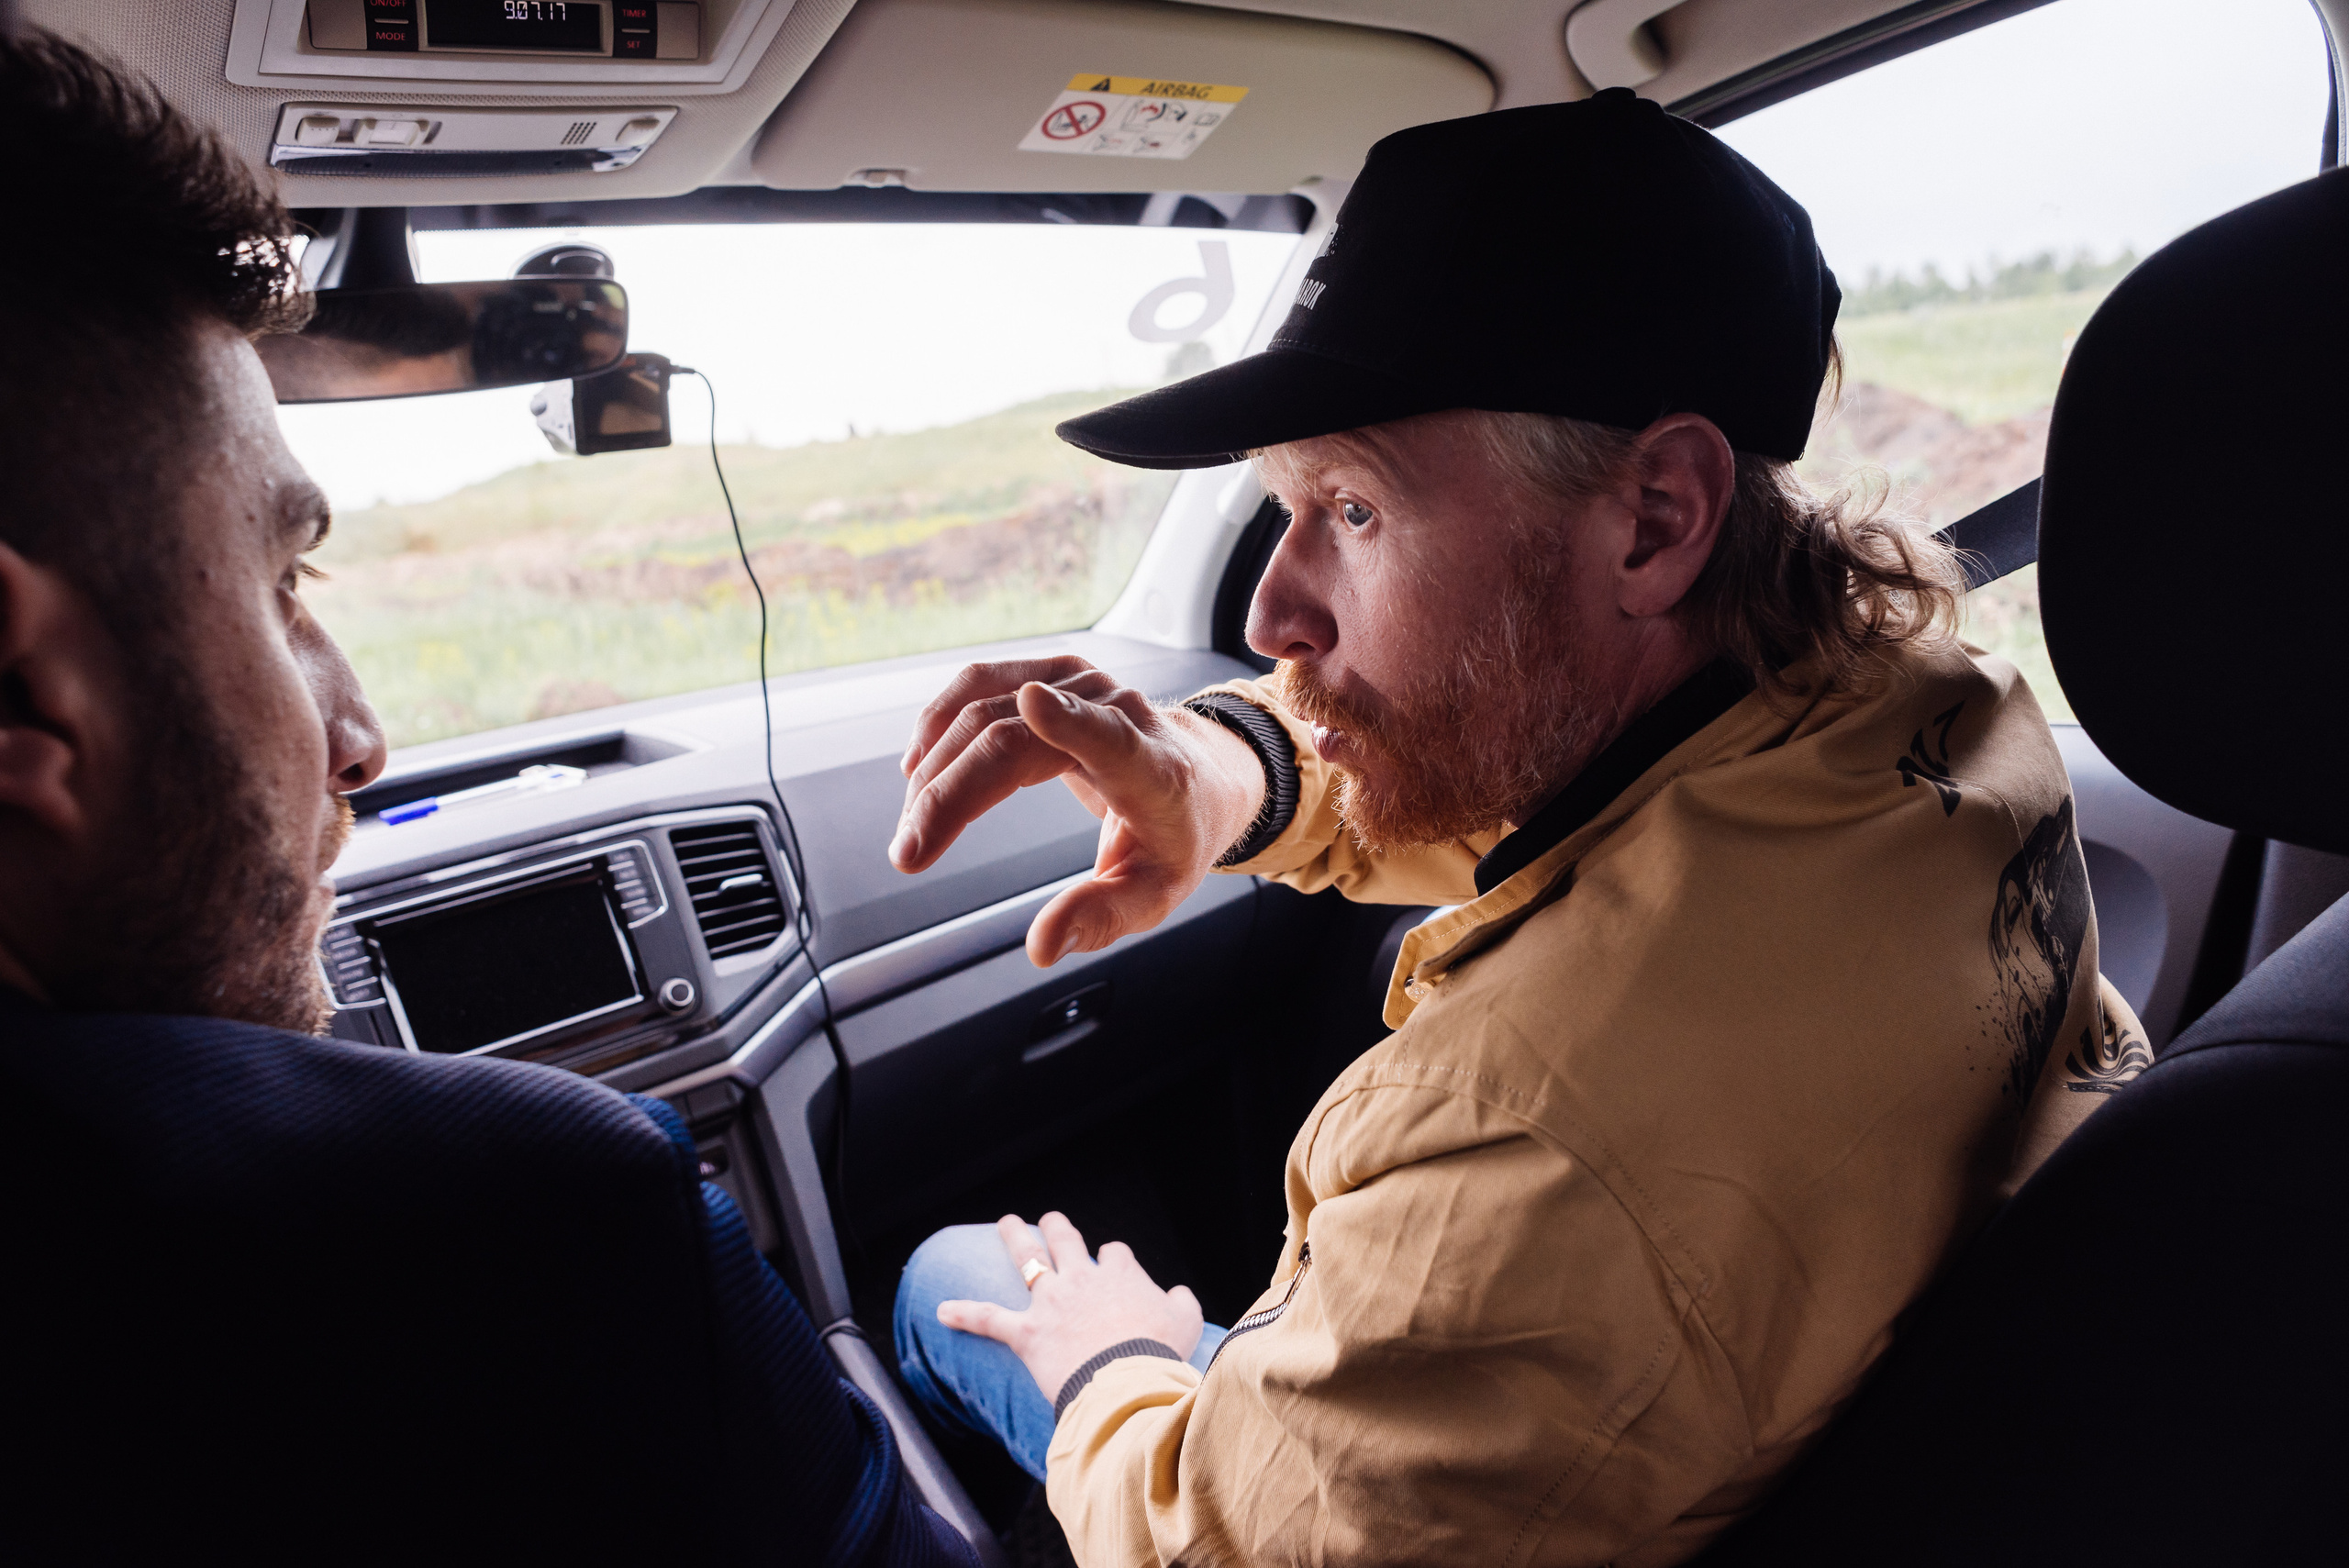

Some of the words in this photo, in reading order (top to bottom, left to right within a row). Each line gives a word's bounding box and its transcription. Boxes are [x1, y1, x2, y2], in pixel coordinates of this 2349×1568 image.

[622, 8, 647, 17] TIMER
[375, 31, 406, 41] MODE
[627, 40, 640, 49] SET
[1140, 82, 1213, 99] AIRBAG
